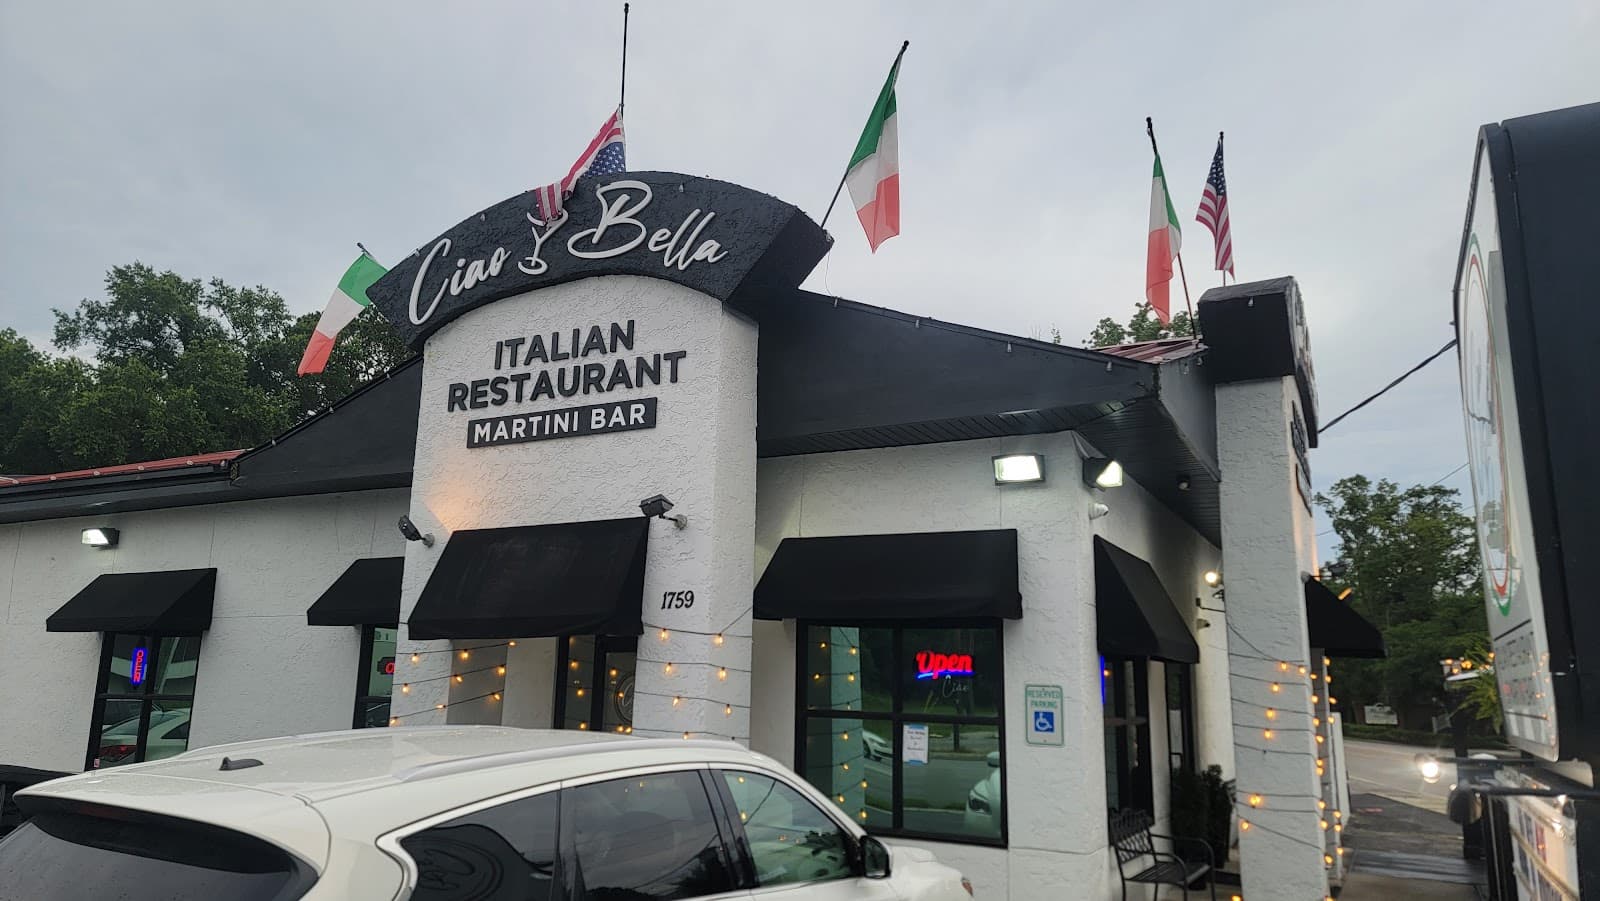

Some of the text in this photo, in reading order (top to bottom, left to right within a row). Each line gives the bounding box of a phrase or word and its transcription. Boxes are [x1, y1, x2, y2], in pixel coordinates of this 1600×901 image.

[408, 180, 729, 326] Ciao Bella
[493, 319, 636, 371] ITALIAN
[446, 350, 687, 413] RESTAURANT
[473, 403, 646, 444] MARTINI BAR
[661, 590, 695, 609] 1759
[915, 651, 973, 680] Open
[1027, 689, 1061, 700] RESERVED
[1031, 700, 1057, 709] PARKING
